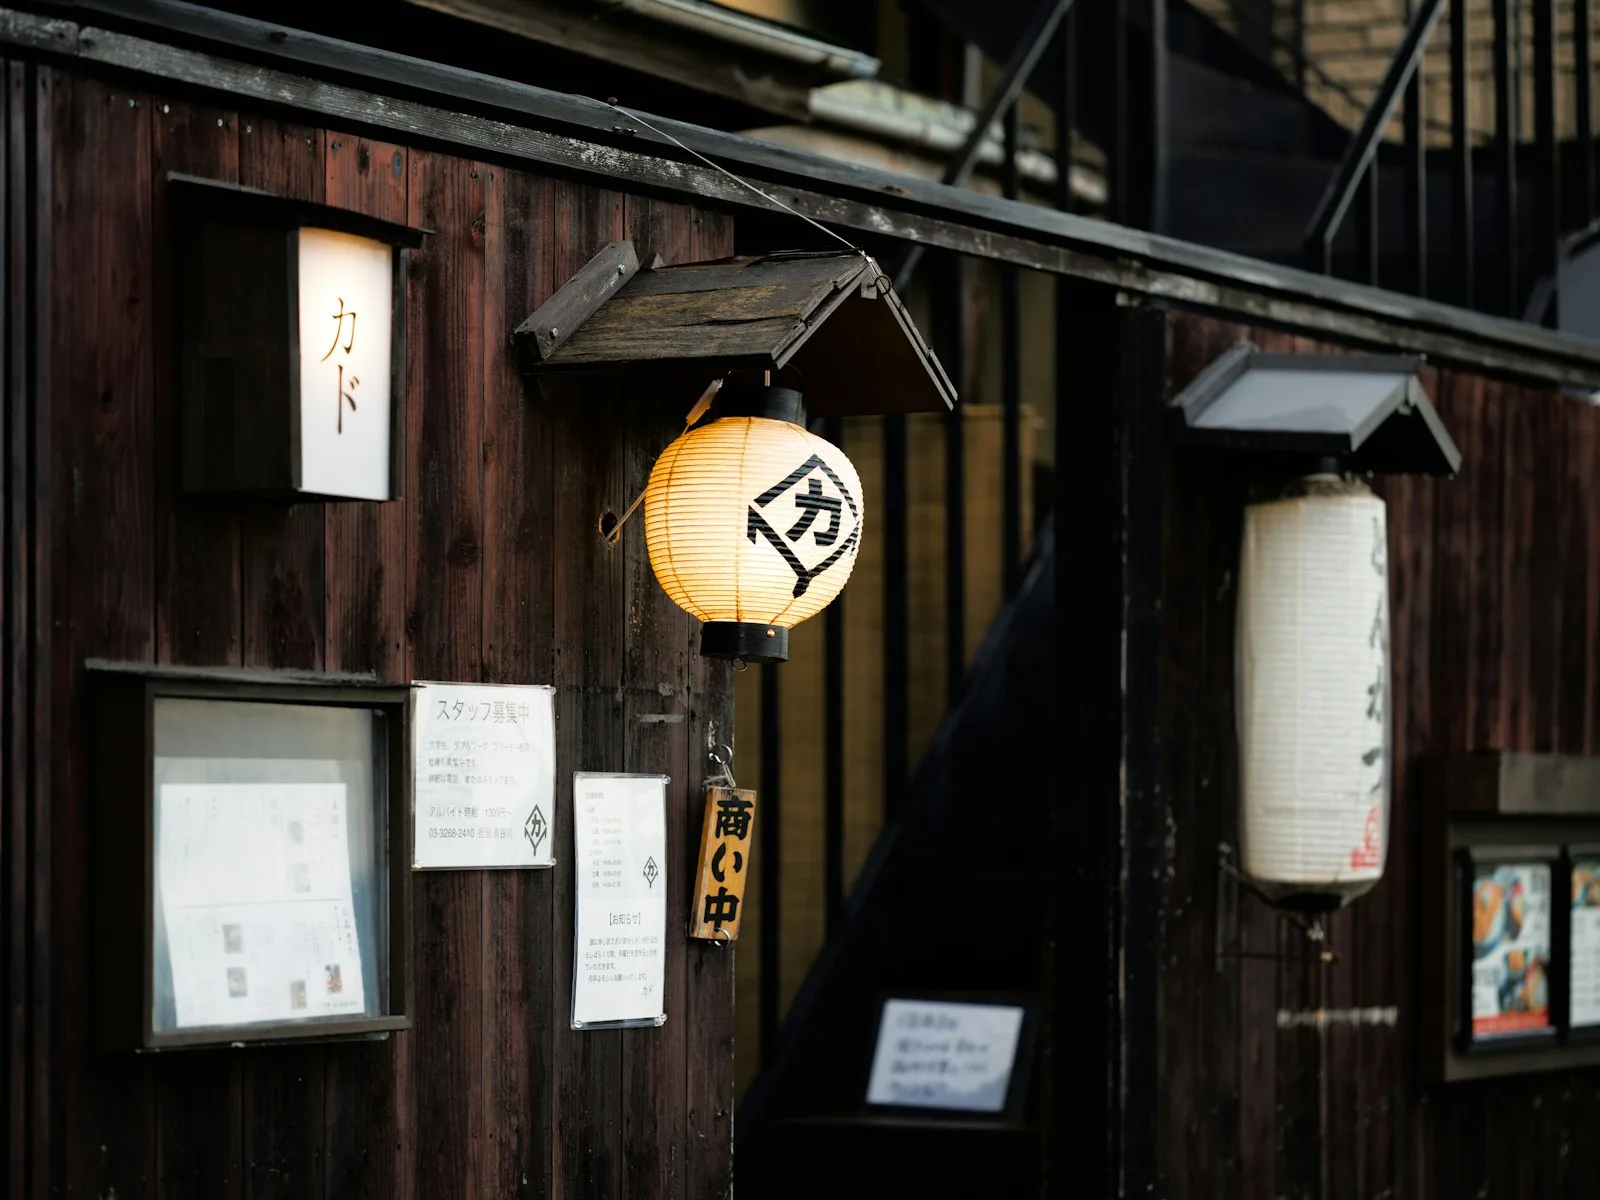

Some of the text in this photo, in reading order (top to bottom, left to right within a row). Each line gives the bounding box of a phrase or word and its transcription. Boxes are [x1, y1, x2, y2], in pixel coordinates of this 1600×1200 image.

[320, 297, 360, 435] カド
[437, 698, 530, 724] スタッフ募集中
[428, 828, 475, 839] 03-3268-2410
[704, 795, 754, 932] 商い中
[609, 912, 641, 927] 【お知らせ】
